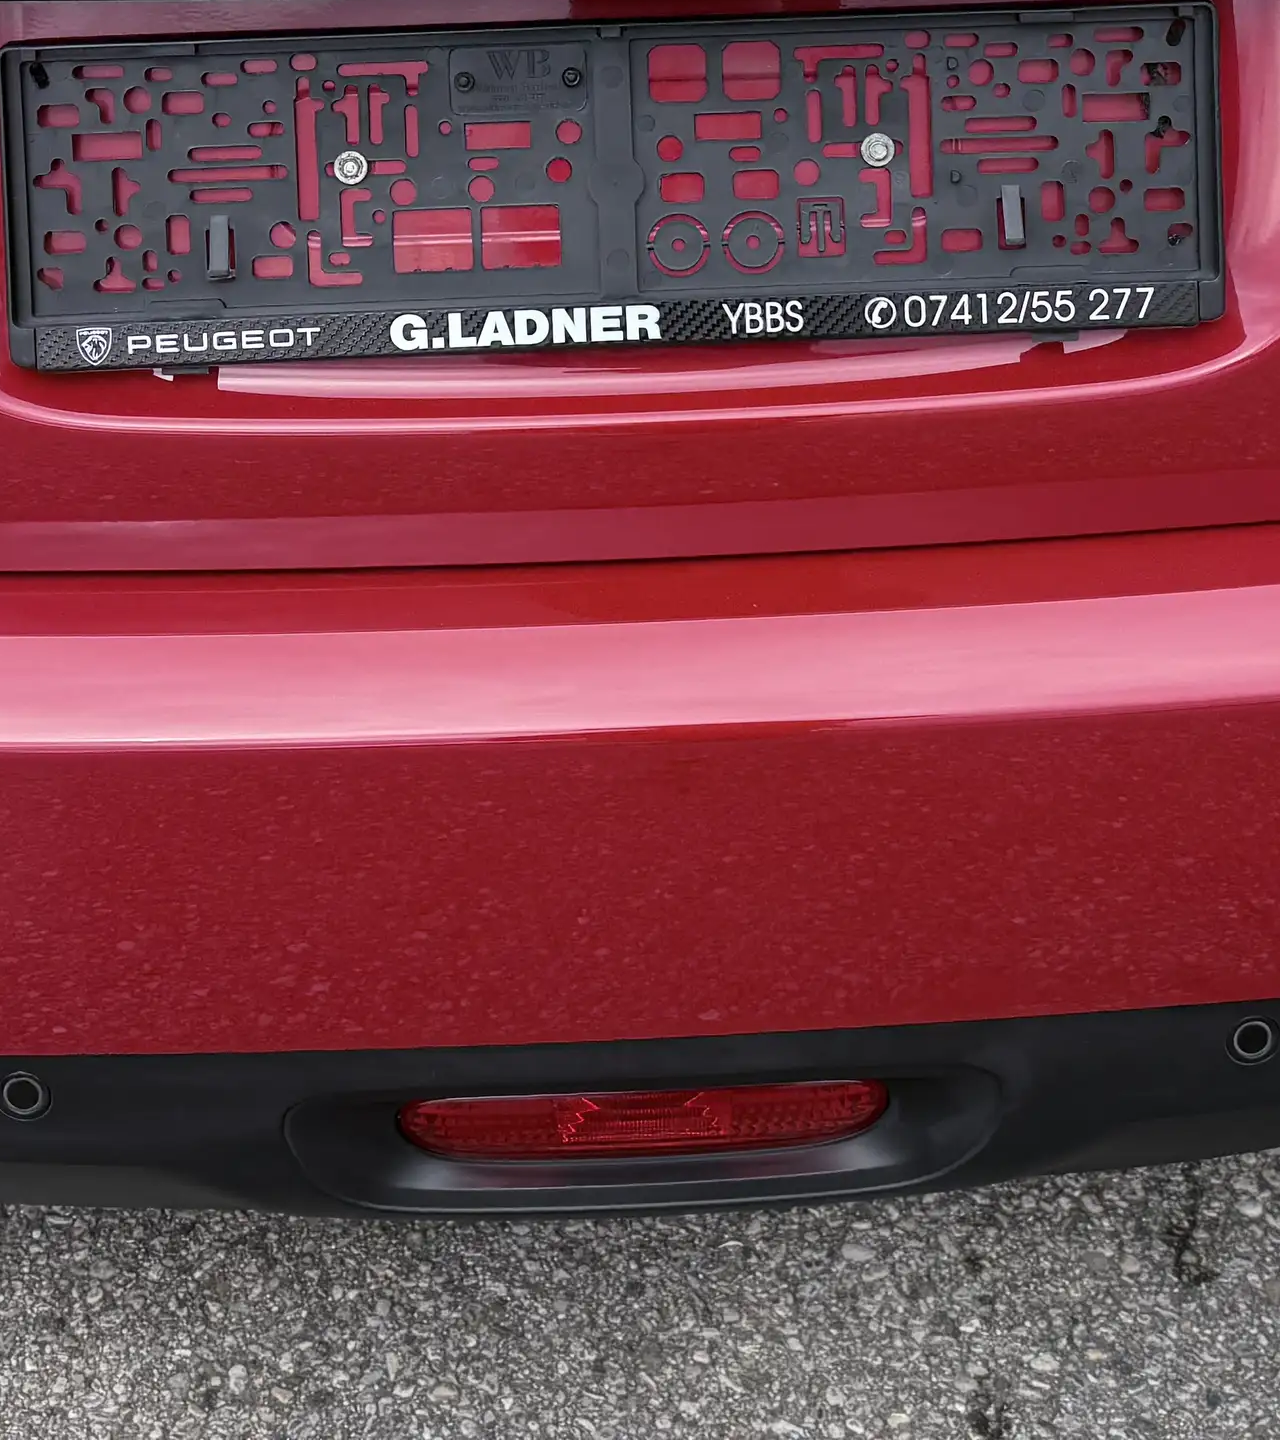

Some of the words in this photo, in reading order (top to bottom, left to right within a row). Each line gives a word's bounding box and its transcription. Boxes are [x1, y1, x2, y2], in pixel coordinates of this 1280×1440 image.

[486, 48, 551, 80] WB
[127, 327, 321, 354] PEUGEOT
[389, 304, 661, 351] G.LADNER
[722, 300, 804, 334] YBBS
[903, 289, 1076, 327] 07412/55
[1088, 287, 1155, 321] 277
